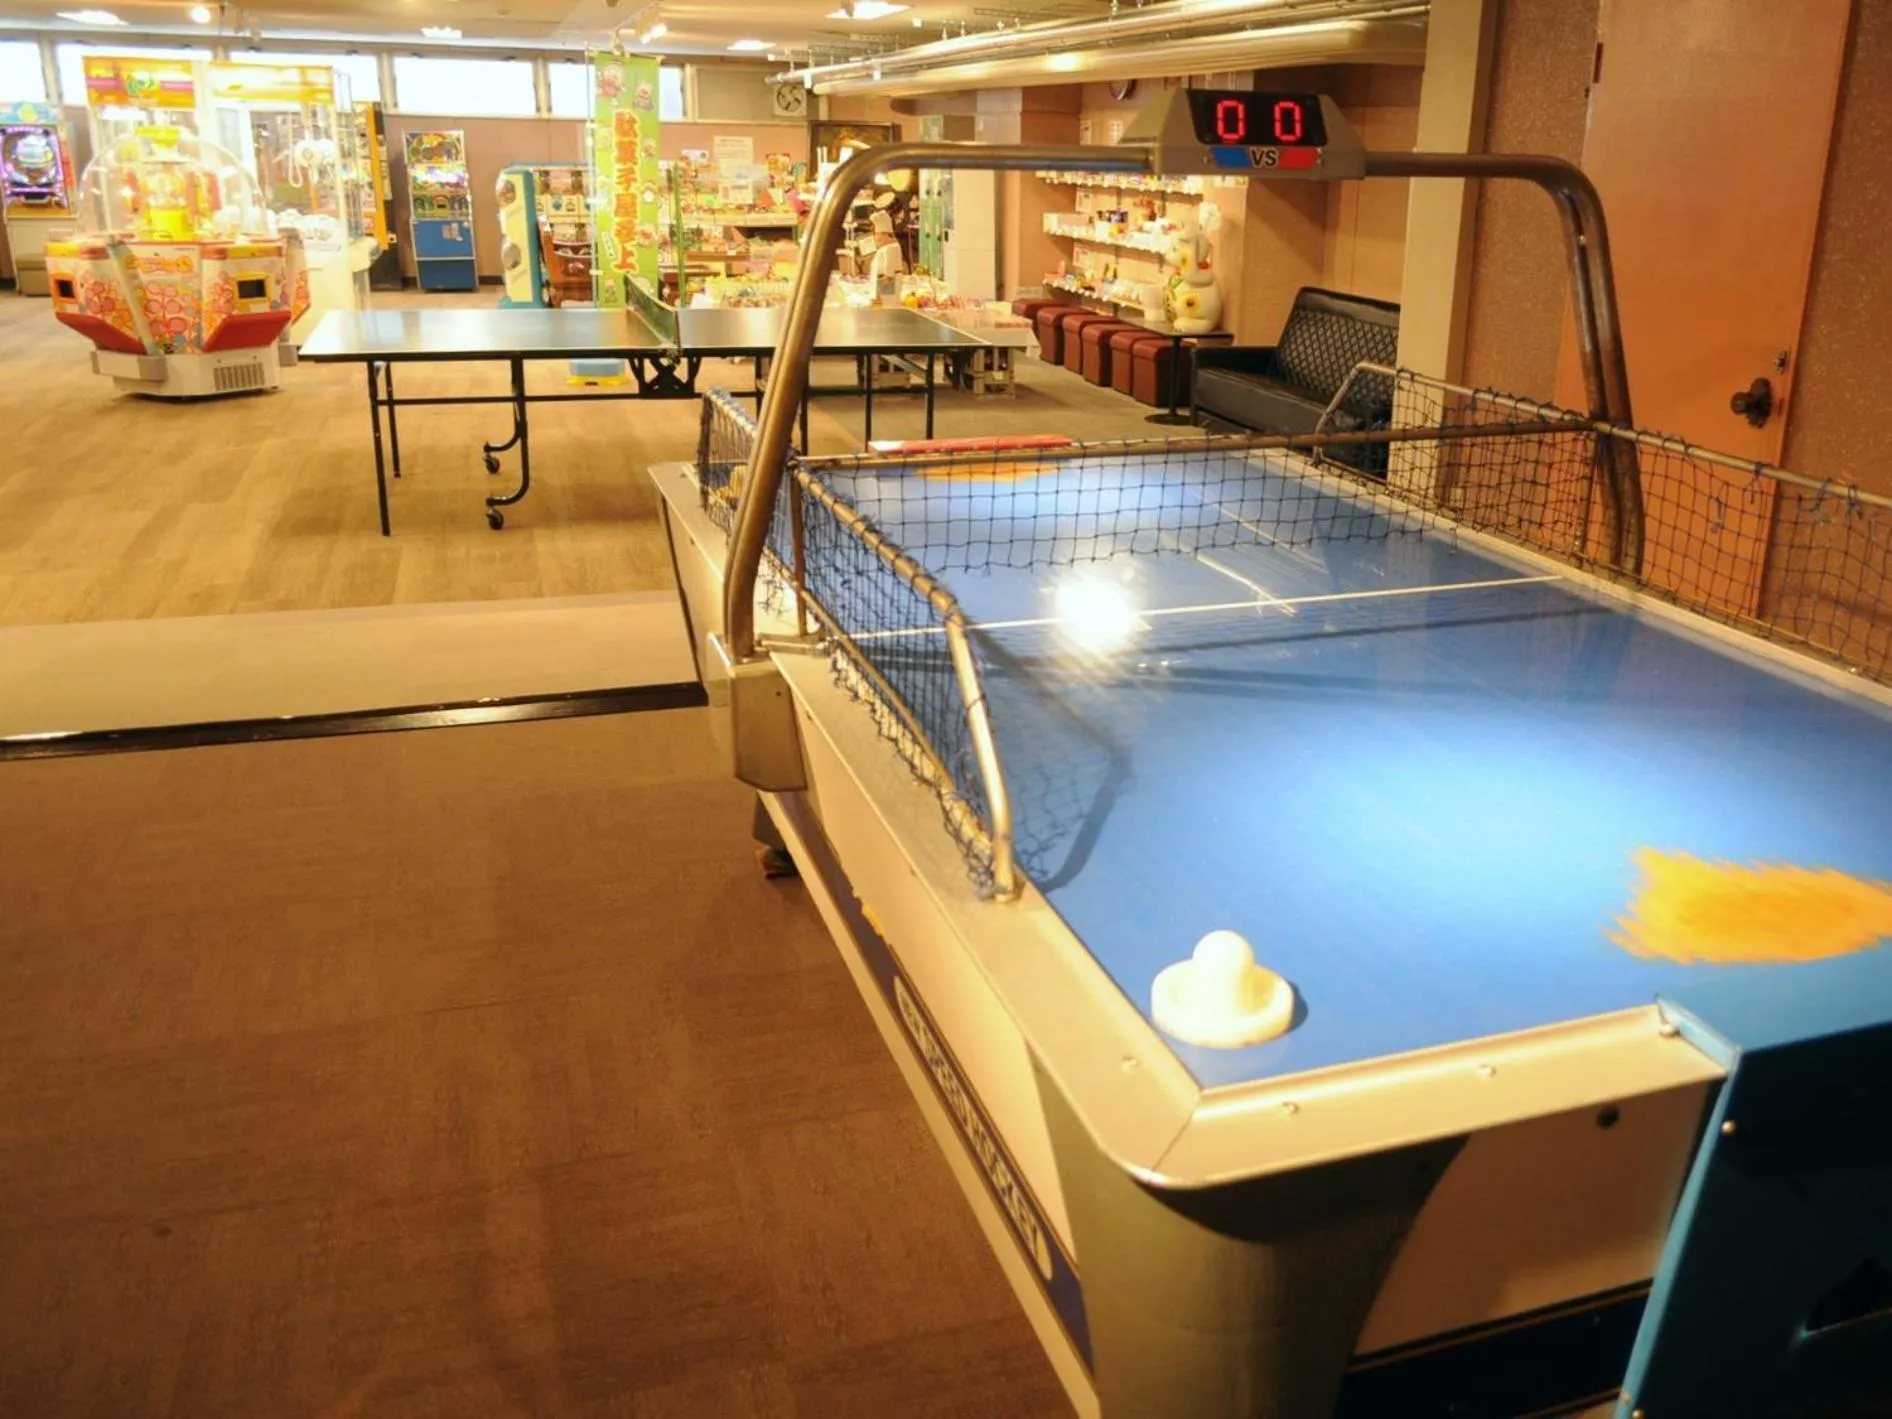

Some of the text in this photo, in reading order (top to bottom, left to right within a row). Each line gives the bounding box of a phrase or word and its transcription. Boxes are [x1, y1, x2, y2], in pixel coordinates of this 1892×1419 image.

[1216, 99, 1302, 142] 0 0
[1252, 150, 1277, 167] VS
